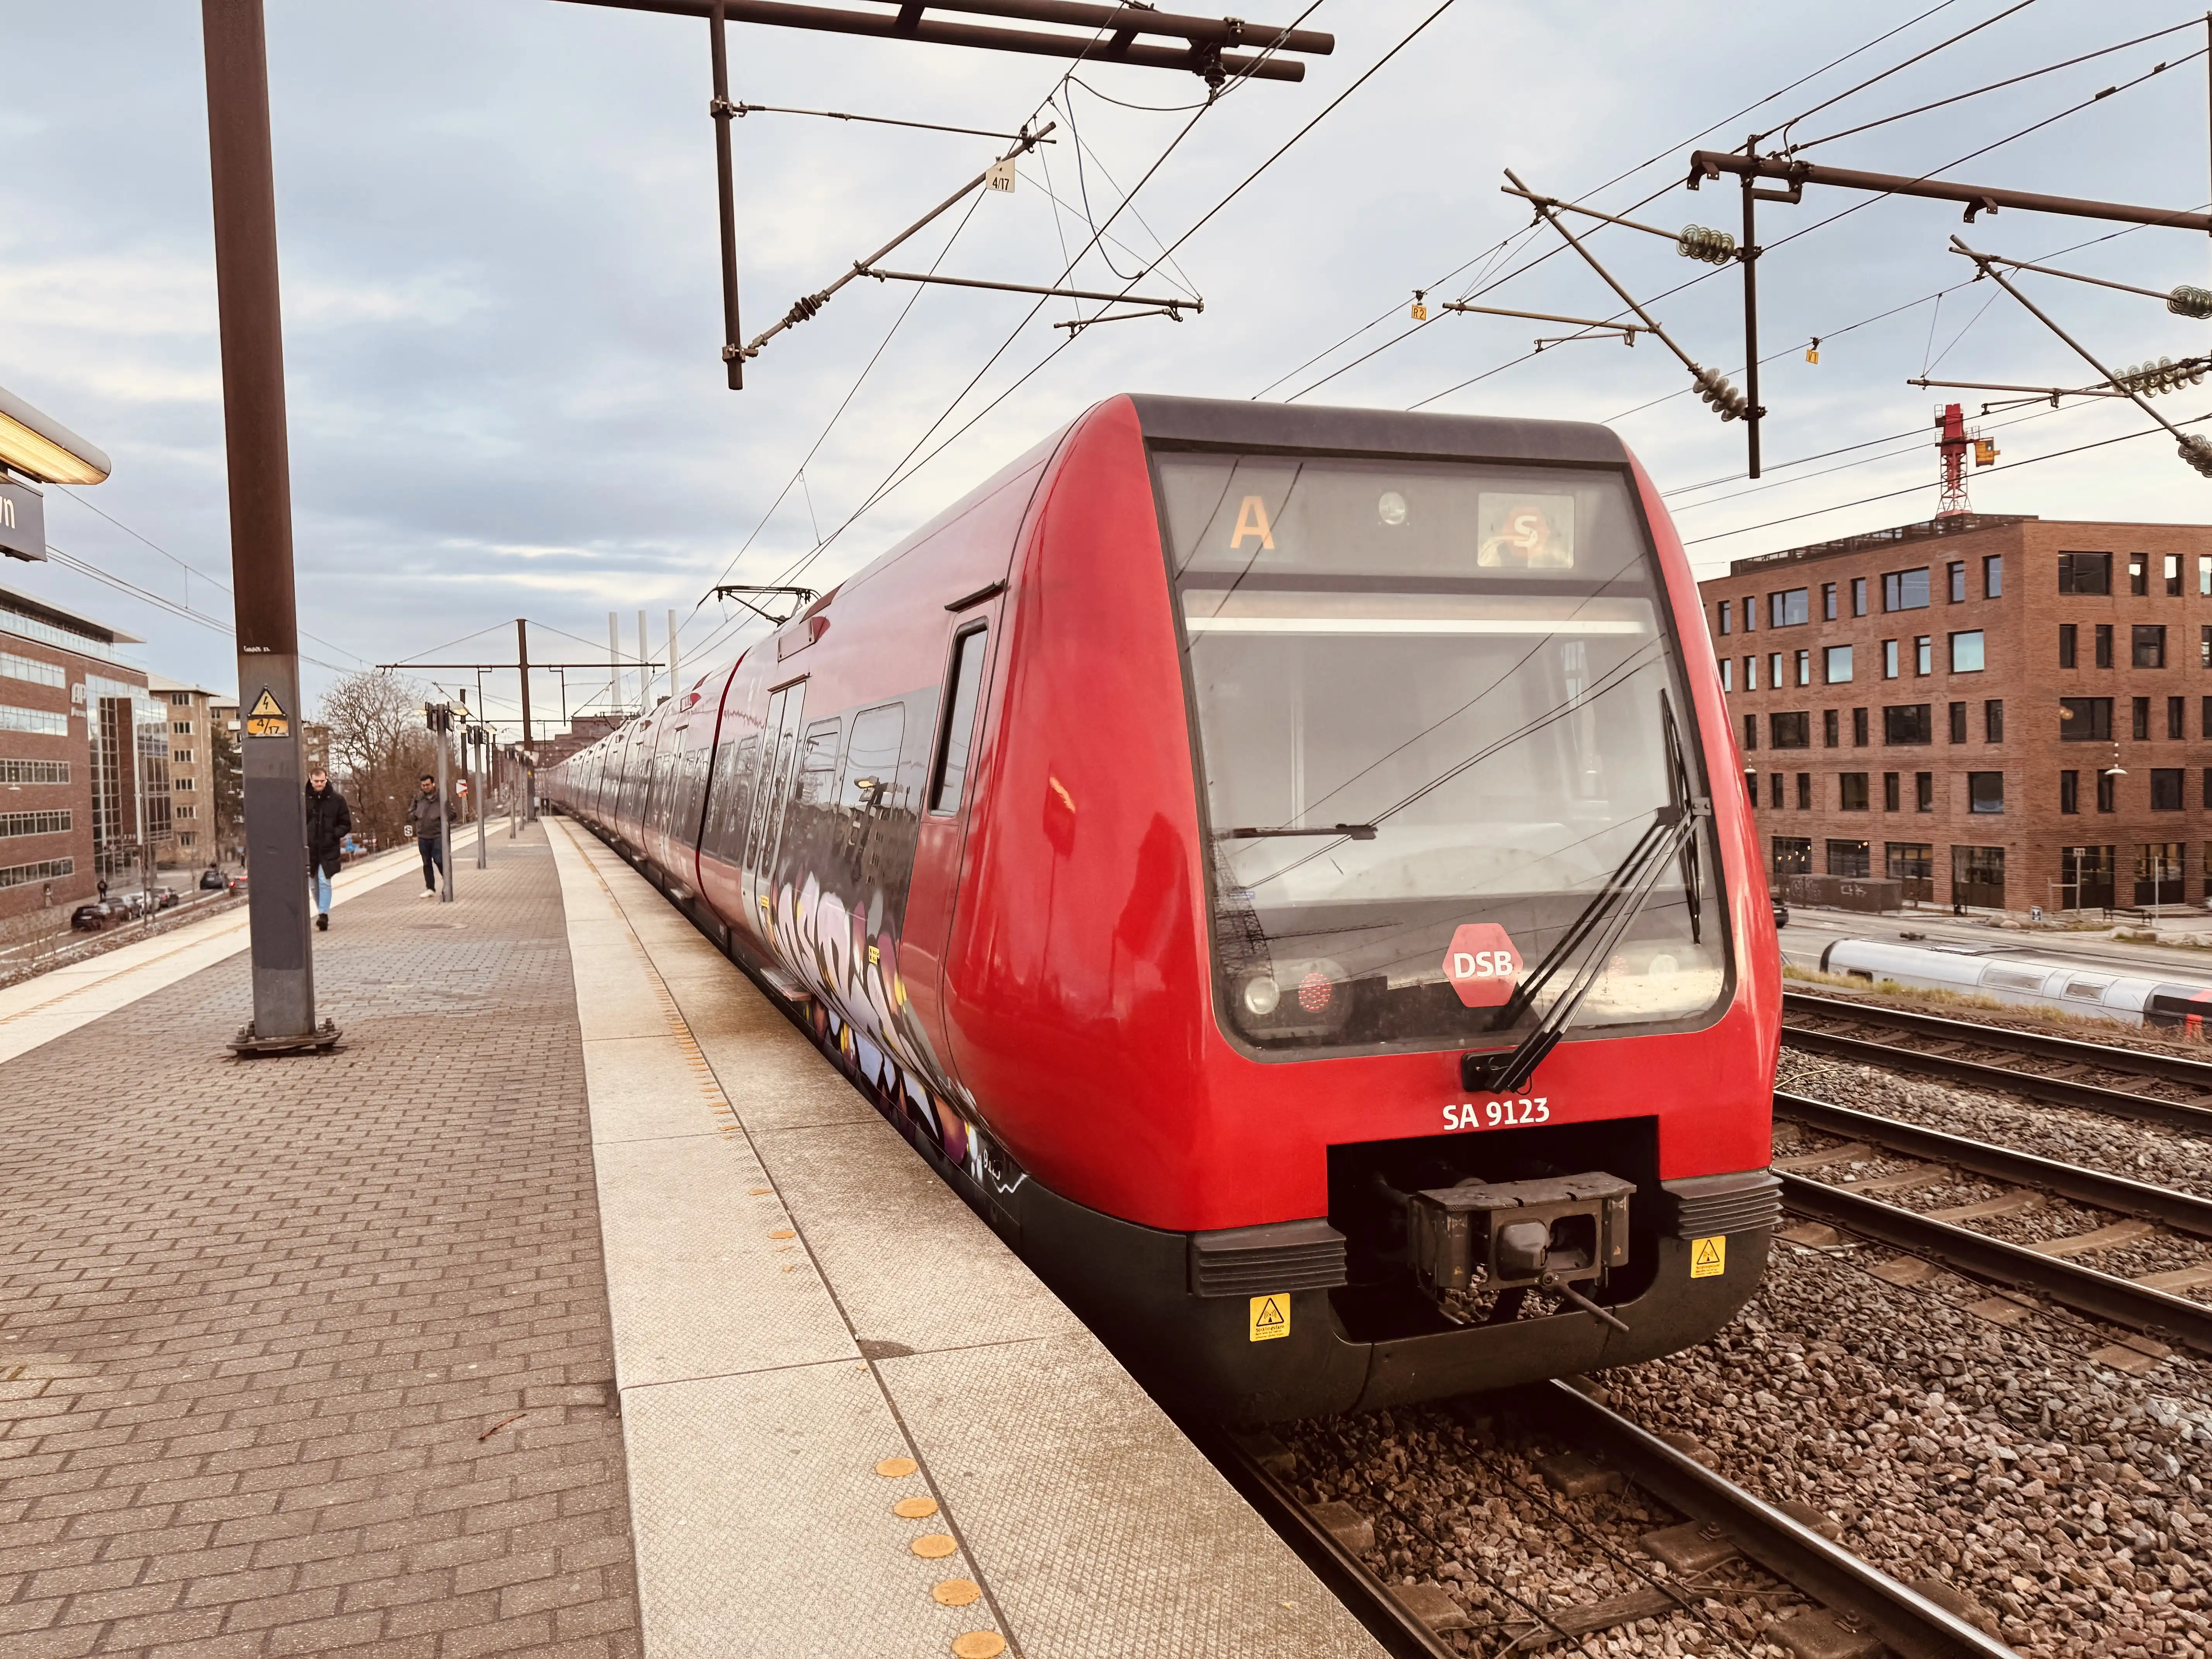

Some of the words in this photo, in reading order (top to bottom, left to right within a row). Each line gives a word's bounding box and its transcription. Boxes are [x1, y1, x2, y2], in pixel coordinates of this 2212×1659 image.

[992, 177, 1009, 191] 4/17
[1230, 496, 1275, 549] A
[1514, 515, 1538, 547] S
[257, 718, 280, 734] 4/17
[1454, 951, 1513, 978] DSB
[1443, 1104, 1479, 1130] SA
[1486, 1097, 1549, 1126] 9123
